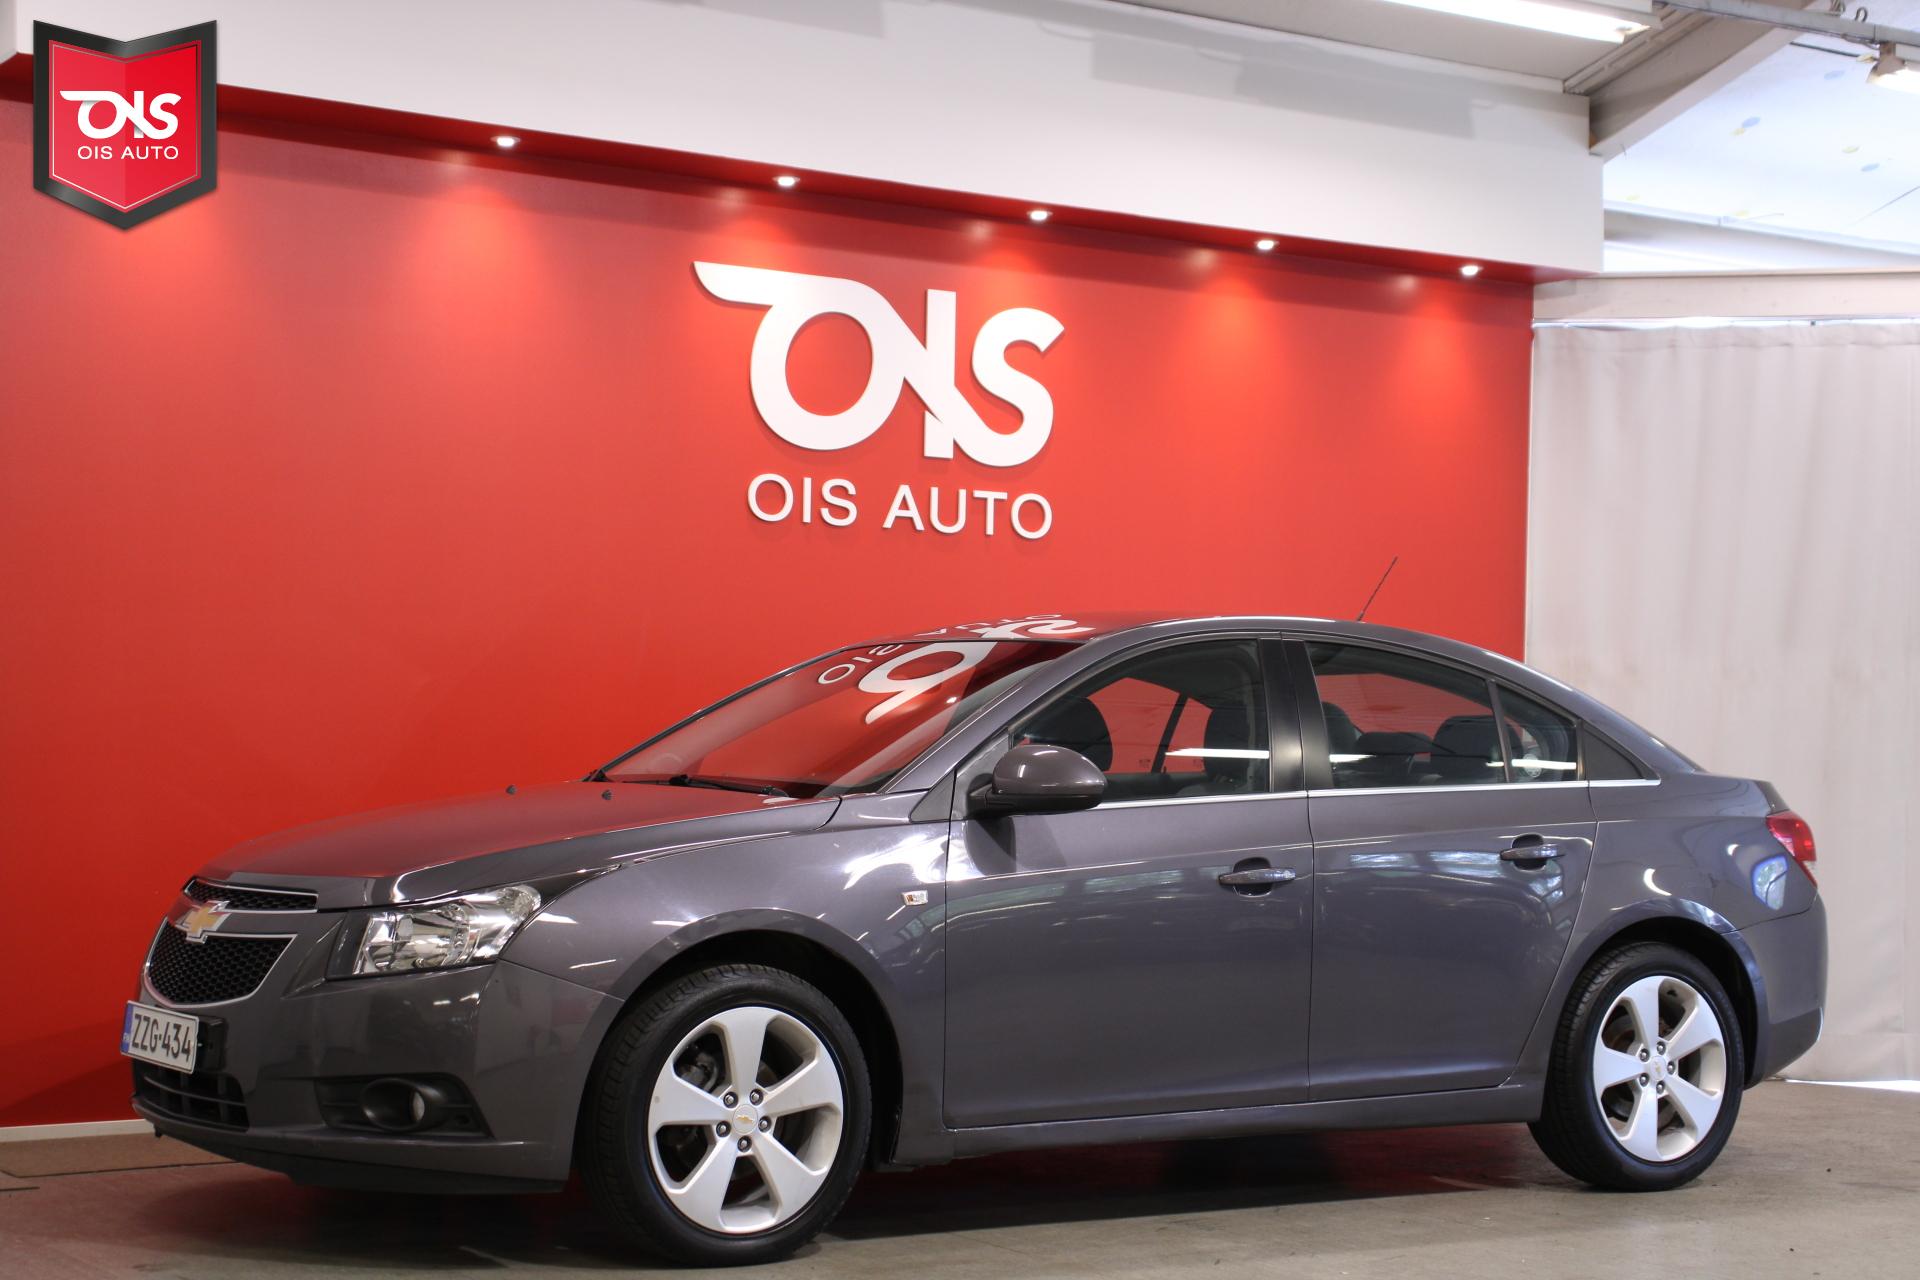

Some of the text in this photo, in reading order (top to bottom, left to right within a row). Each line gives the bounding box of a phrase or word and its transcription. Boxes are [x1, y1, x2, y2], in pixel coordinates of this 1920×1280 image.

[747, 473, 1053, 540] OIS AUTO
[131, 1013, 191, 1062] ZZG-434
